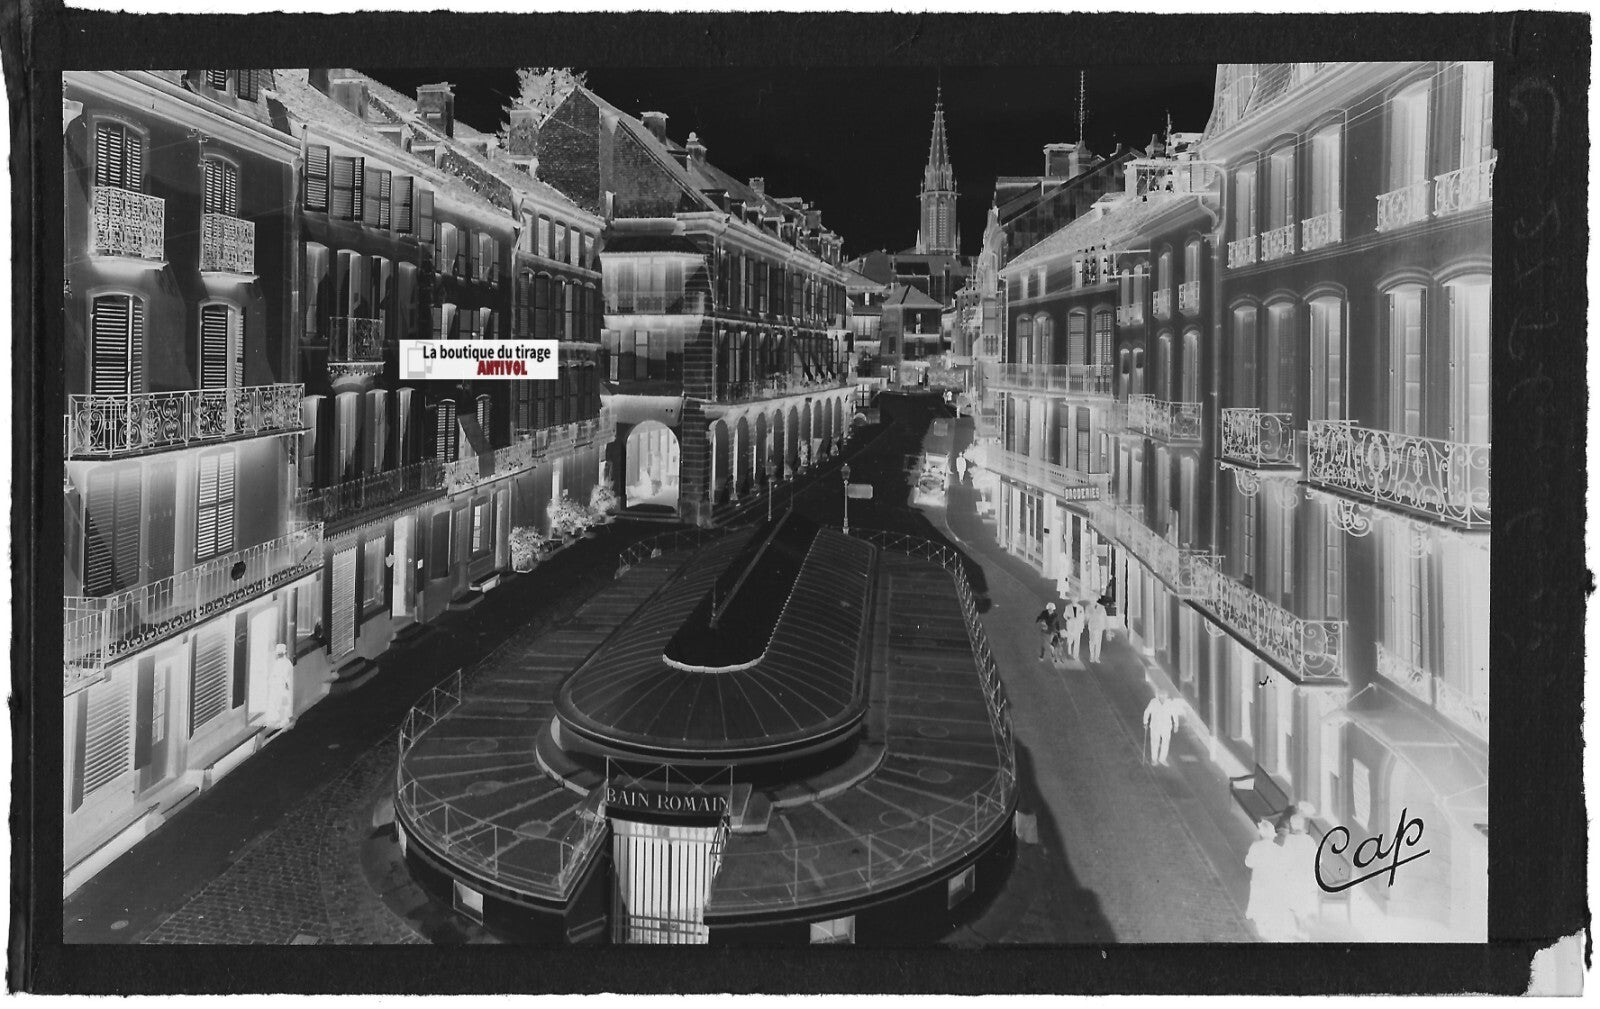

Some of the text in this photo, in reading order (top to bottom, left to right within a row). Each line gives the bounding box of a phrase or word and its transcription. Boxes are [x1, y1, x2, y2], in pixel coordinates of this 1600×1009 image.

[1065, 488, 1099, 500] BRODERIES
[606, 787, 730, 812] BAIN ROMAIN
